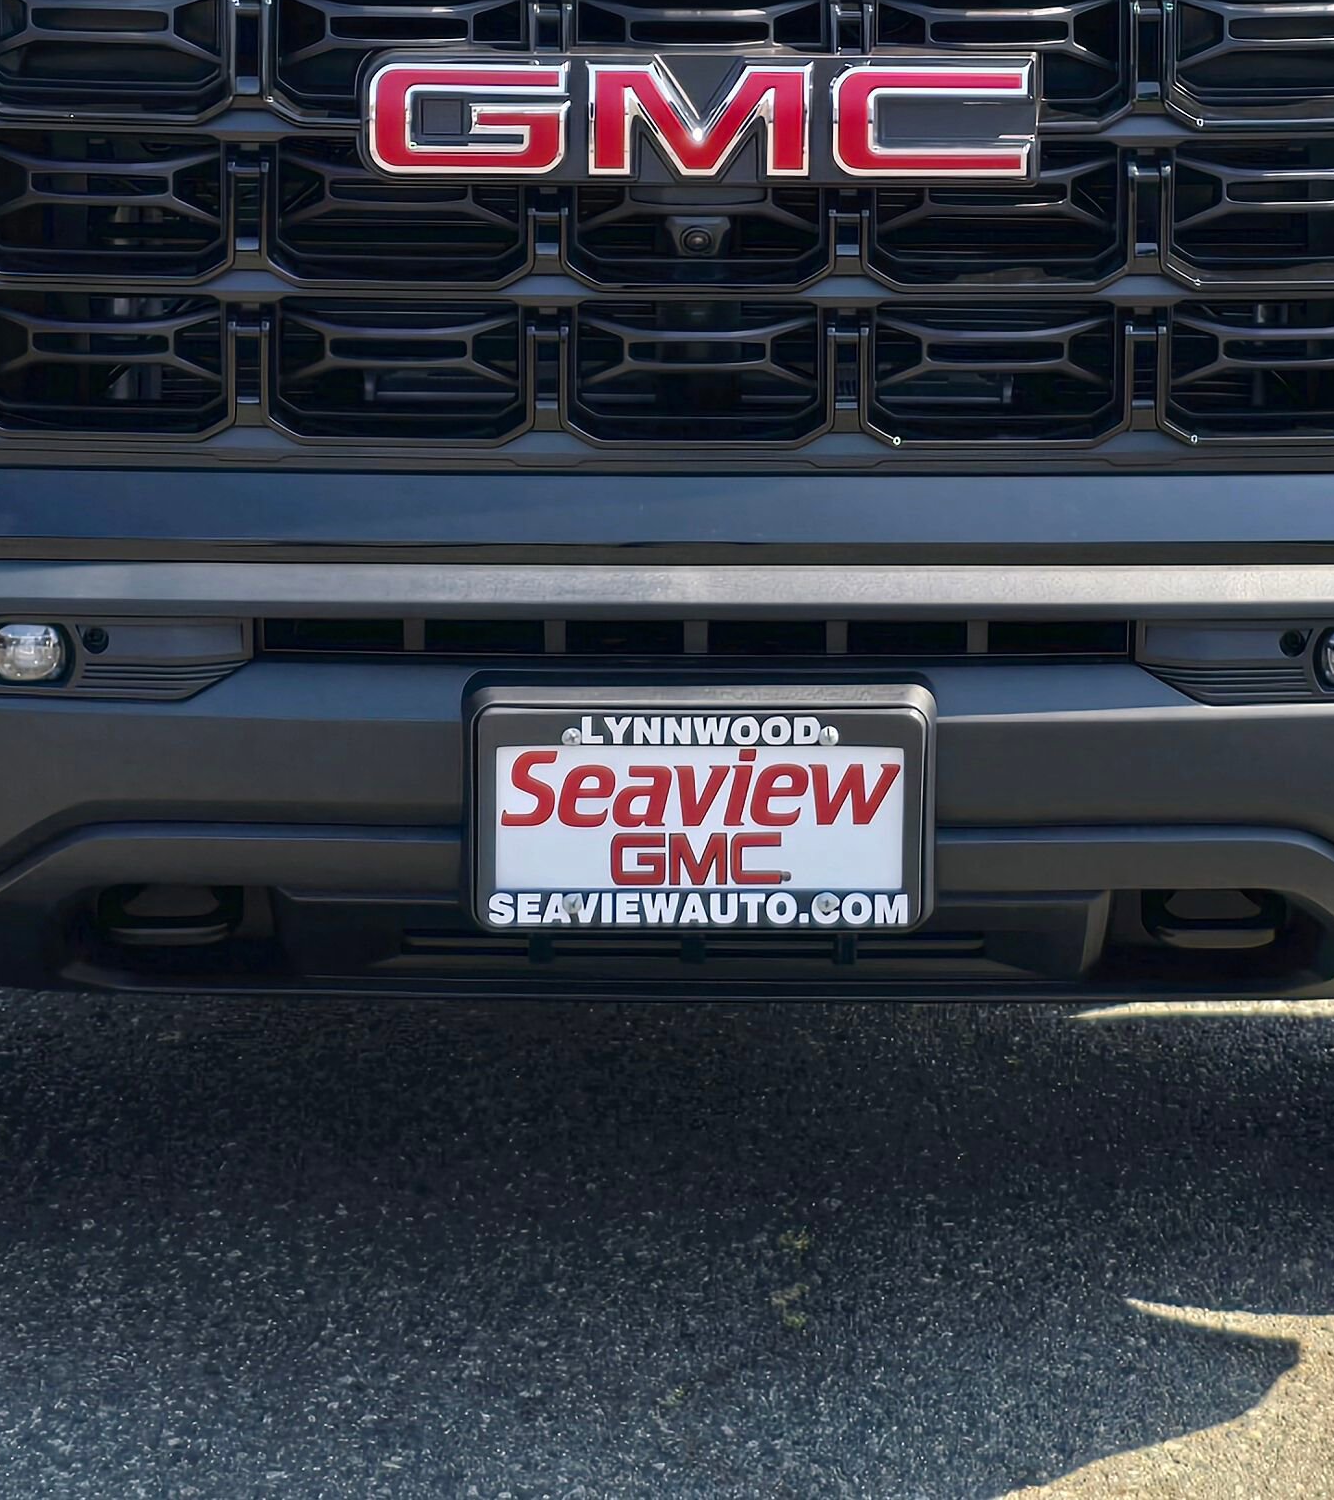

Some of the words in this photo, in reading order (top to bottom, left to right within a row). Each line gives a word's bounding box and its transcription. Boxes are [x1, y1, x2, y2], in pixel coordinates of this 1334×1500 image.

[368, 60, 1035, 179] GMC
[580, 716, 821, 746] LYNNWOOD
[500, 748, 902, 828] Seaview
[609, 831, 783, 887] GMC
[487, 892, 909, 925] SEAVIEWAUTO.COM
